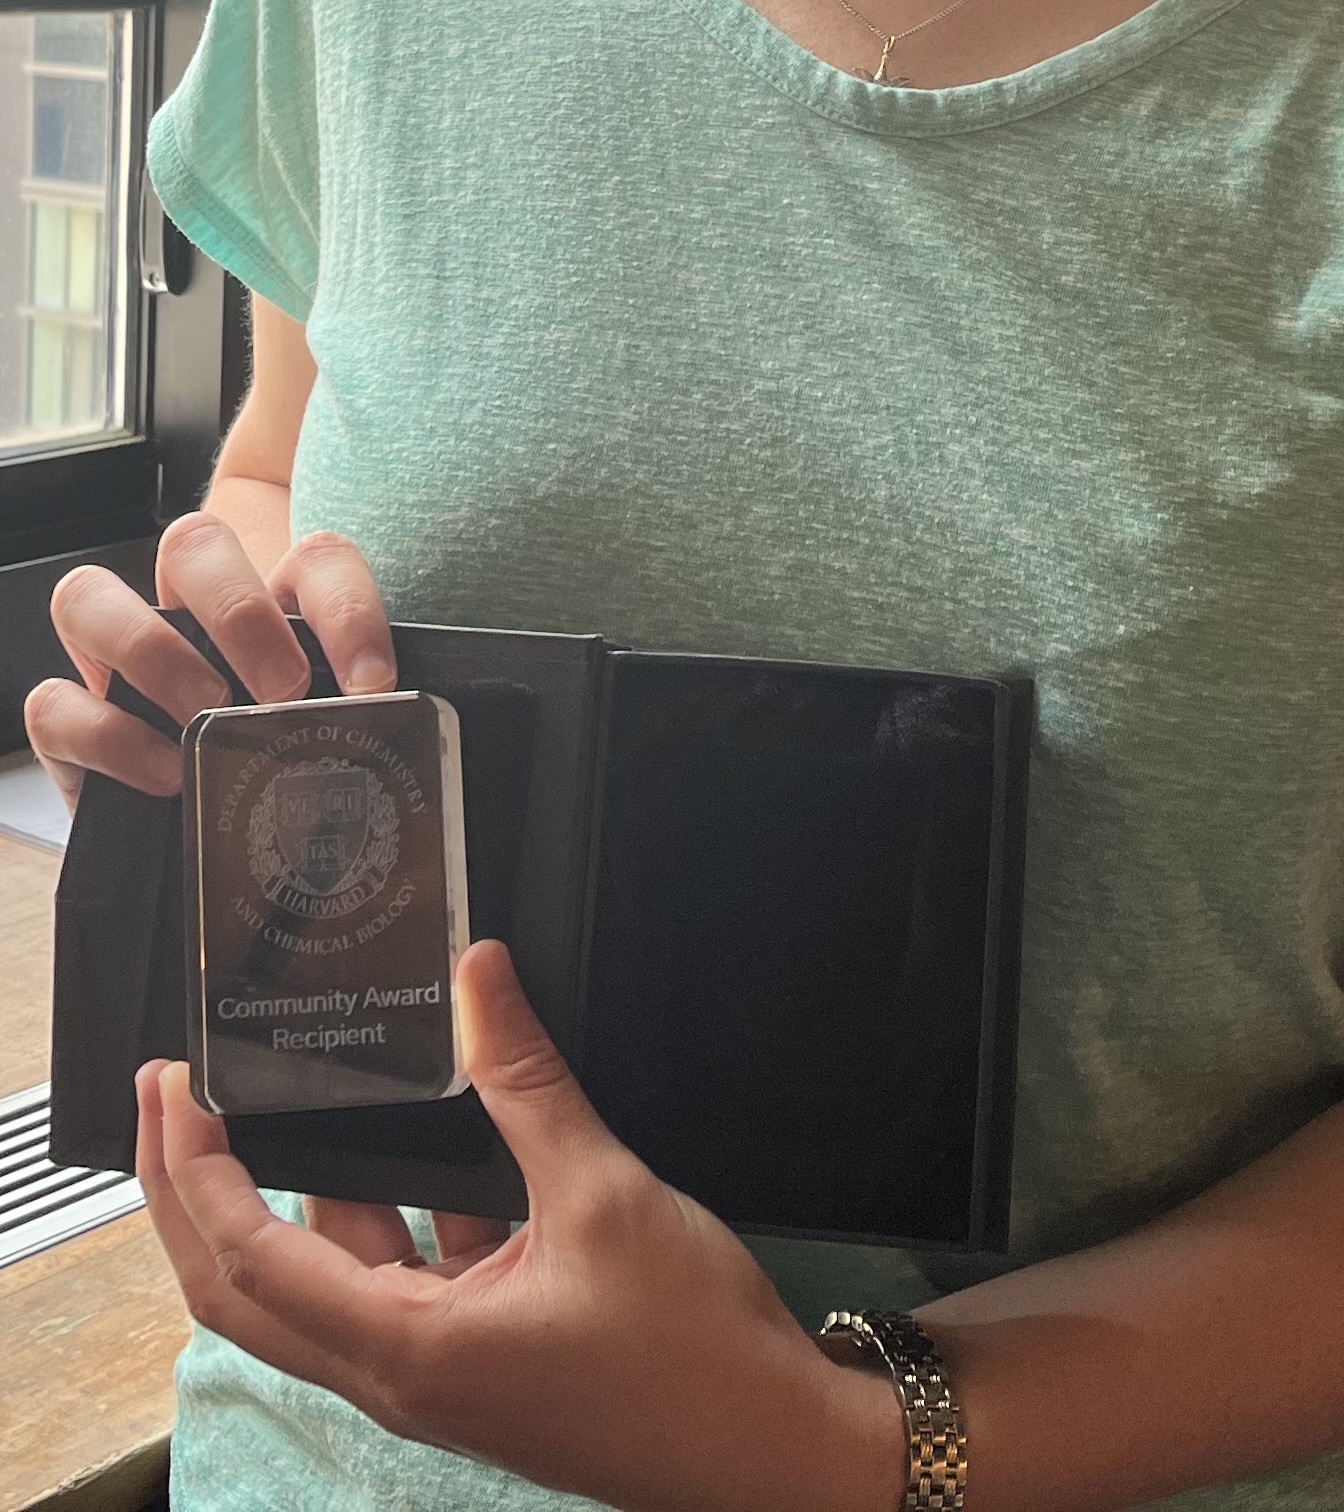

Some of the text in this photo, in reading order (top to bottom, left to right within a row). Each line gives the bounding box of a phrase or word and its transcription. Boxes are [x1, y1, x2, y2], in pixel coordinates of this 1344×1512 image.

[217, 725, 429, 832] DEPARTMENT OF CHEMISTRY
[283, 887, 366, 915] HARVARD
[231, 896, 264, 929] AND
[264, 926, 355, 955] CHEMICAL
[217, 980, 441, 1019] Community Award
[272, 1022, 387, 1053] Recipient
